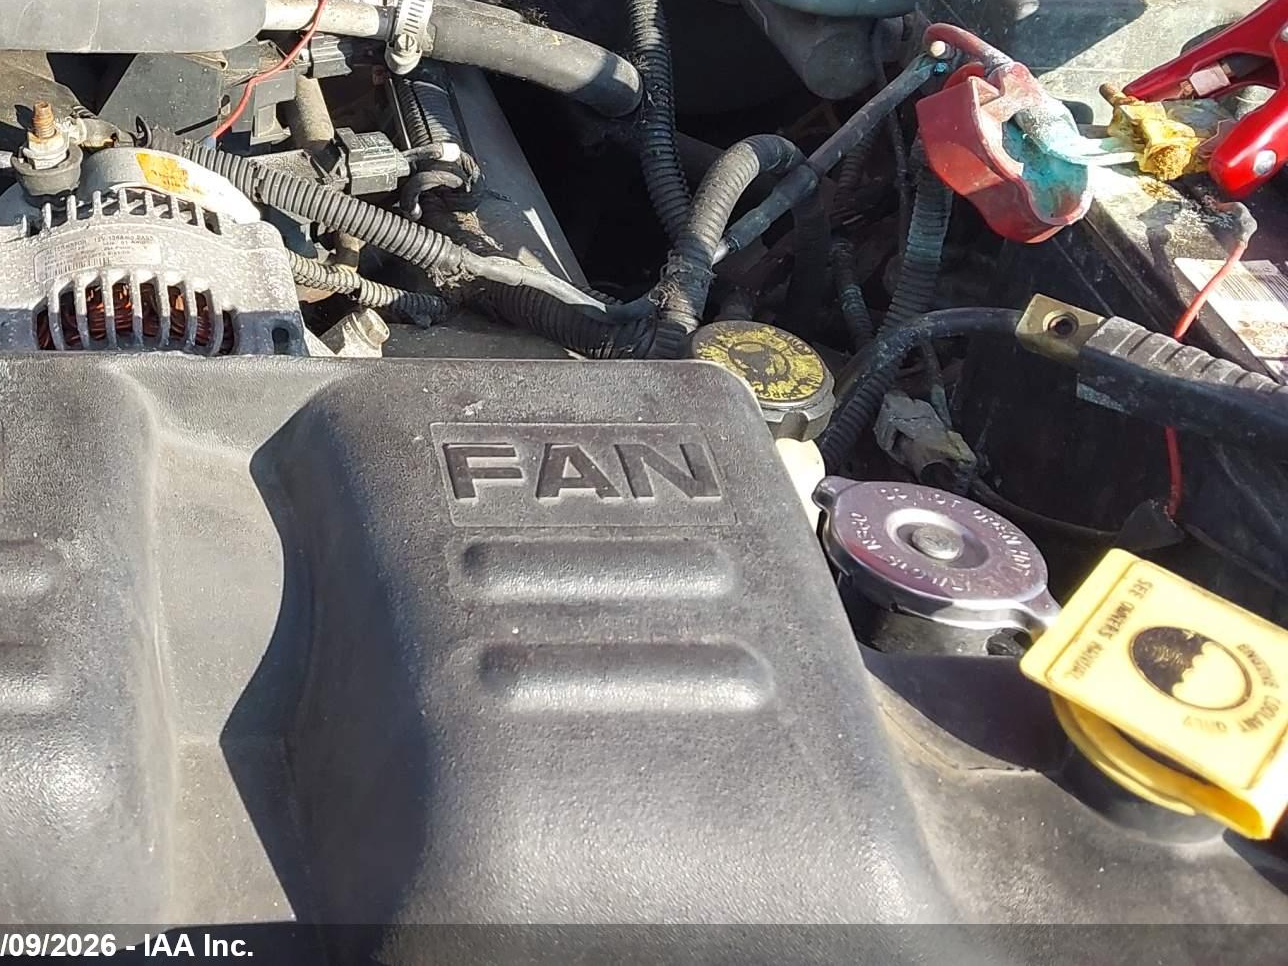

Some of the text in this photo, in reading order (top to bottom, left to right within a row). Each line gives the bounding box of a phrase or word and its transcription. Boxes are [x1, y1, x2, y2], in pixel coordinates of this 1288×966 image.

[442, 442, 723, 501] FAN
[1127, 577, 1154, 600] SEE
[1097, 600, 1136, 641] OWNERS
